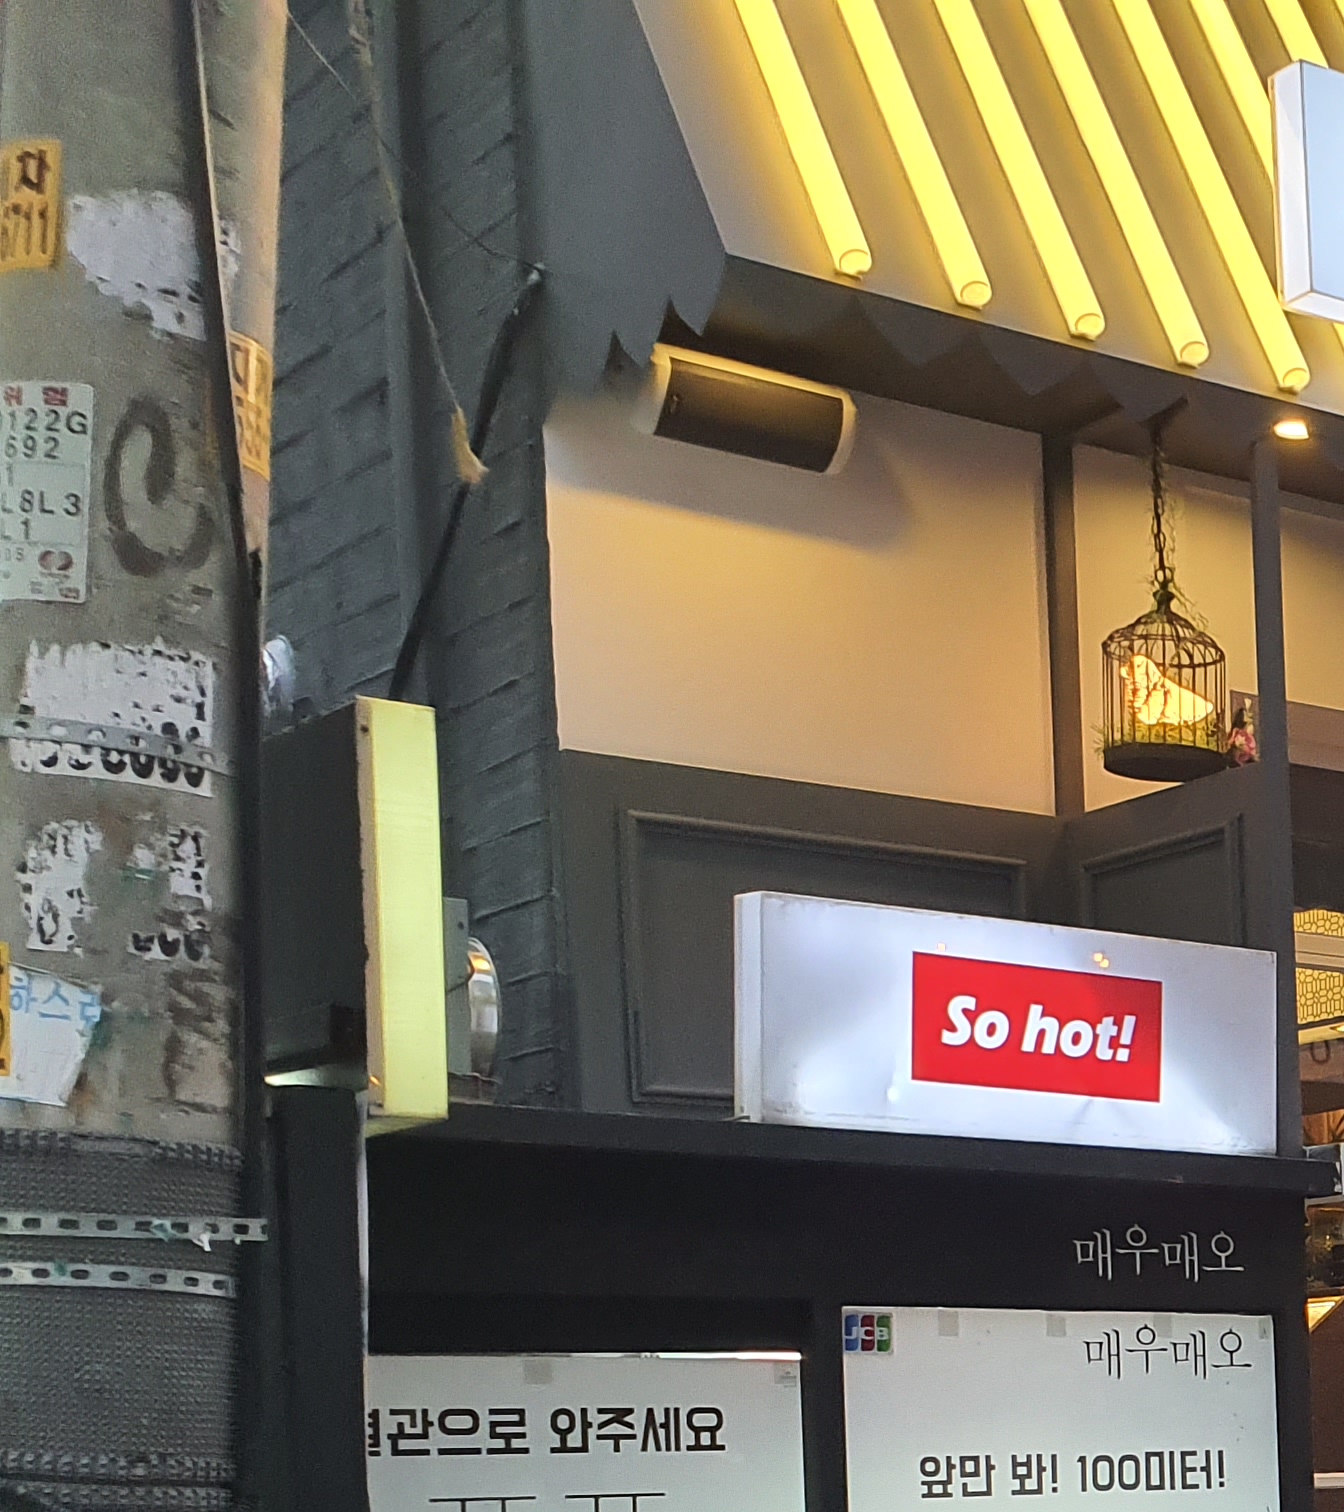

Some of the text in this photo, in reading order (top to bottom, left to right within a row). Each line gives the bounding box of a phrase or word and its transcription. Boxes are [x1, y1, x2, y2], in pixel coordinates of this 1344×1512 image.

[941, 995, 1138, 1062] So hot!
[1072, 1223, 1245, 1282] 매우매오
[844, 1325, 890, 1342] JCB
[1083, 1324, 1252, 1379] 매우매오
[550, 1406, 726, 1453] 와주세요
[919, 1449, 1227, 1499] 앞만 봐! 100미터!
